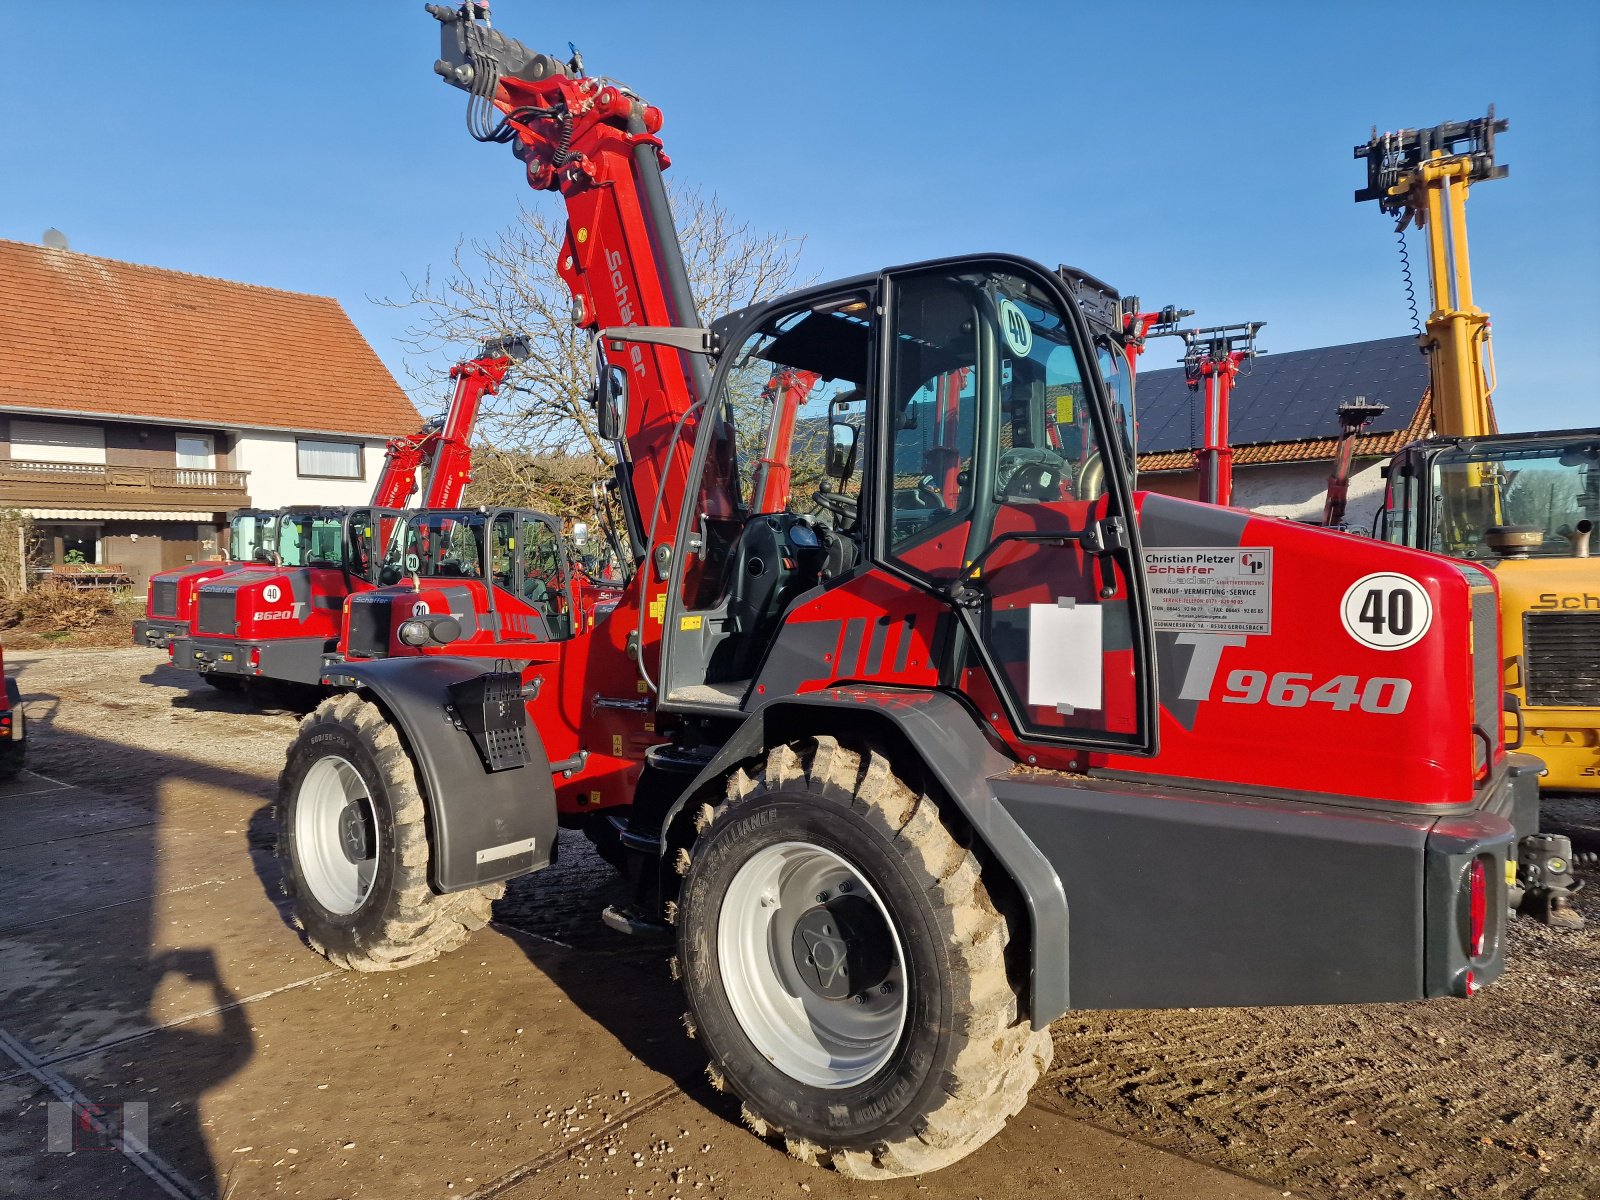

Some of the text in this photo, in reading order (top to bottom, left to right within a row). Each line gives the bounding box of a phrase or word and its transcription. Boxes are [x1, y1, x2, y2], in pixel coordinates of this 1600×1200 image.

[1008, 309, 1027, 346] 40
[408, 557, 417, 569] 20
[1145, 554, 1235, 565] Christian Pletzer
[1147, 565, 1215, 575] Schäffer
[267, 588, 277, 600] 40
[1151, 587, 1180, 595] VERKAUF
[1184, 588, 1226, 596] VERMIETUNG
[1358, 588, 1413, 636] 40
